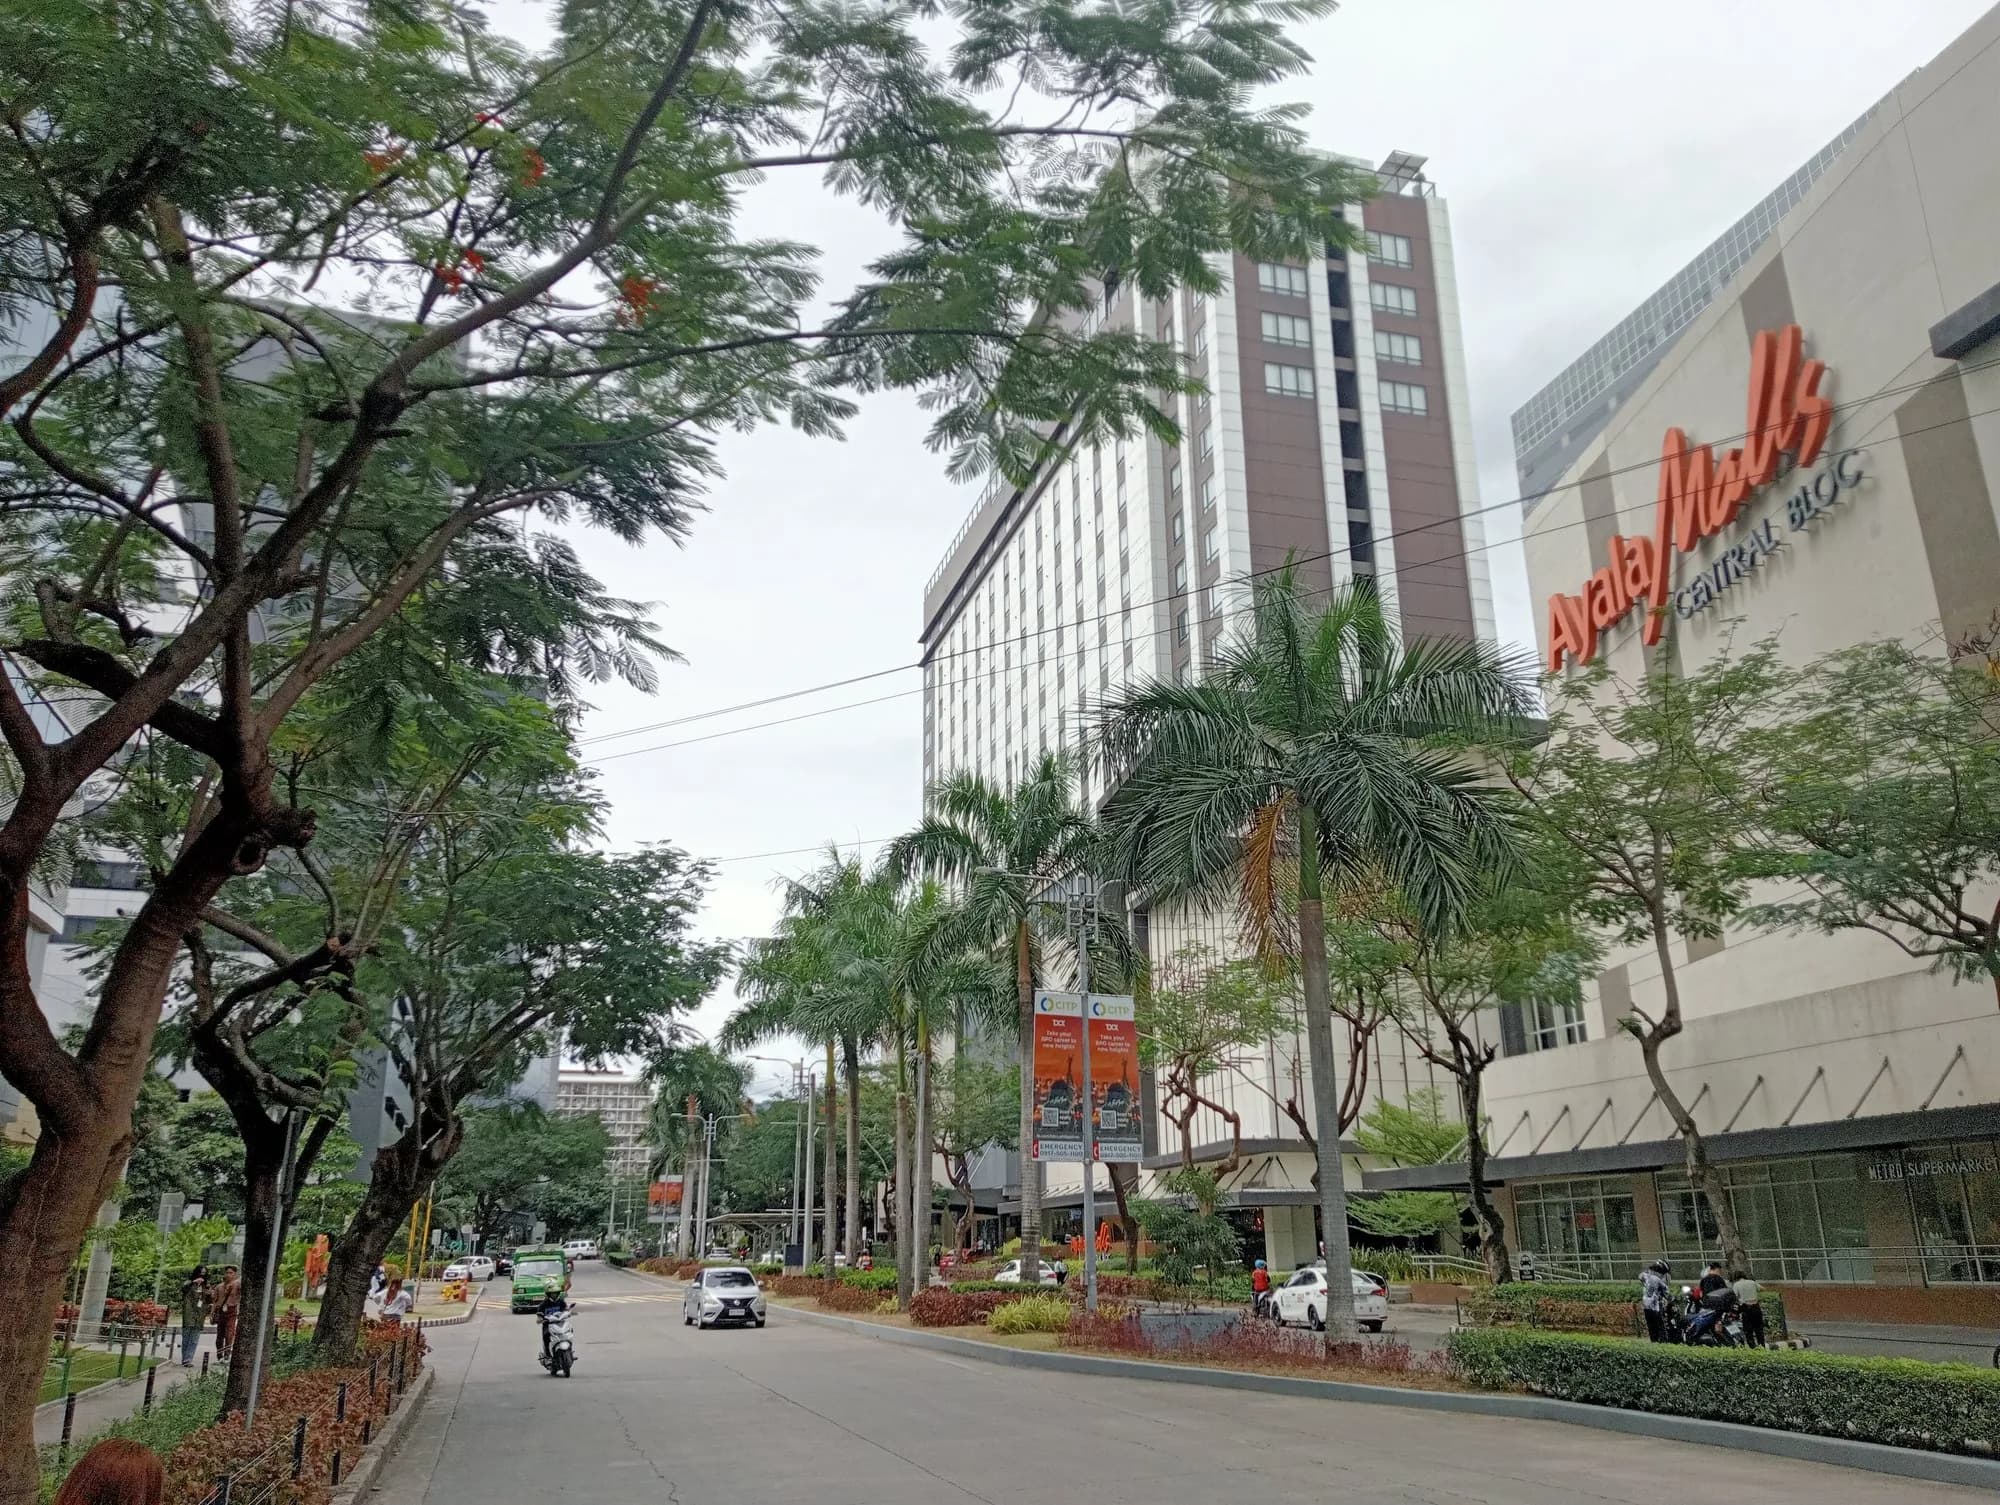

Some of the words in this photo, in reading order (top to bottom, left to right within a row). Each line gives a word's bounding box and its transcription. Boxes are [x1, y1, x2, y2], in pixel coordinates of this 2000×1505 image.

[1547, 535, 1655, 673] Ayala
[1642, 323, 1833, 646] Malls
[1674, 518, 1781, 620] CENTRAL
[1786, 450, 1865, 532] BLOC
[1869, 1163, 1903, 1180] METRO
